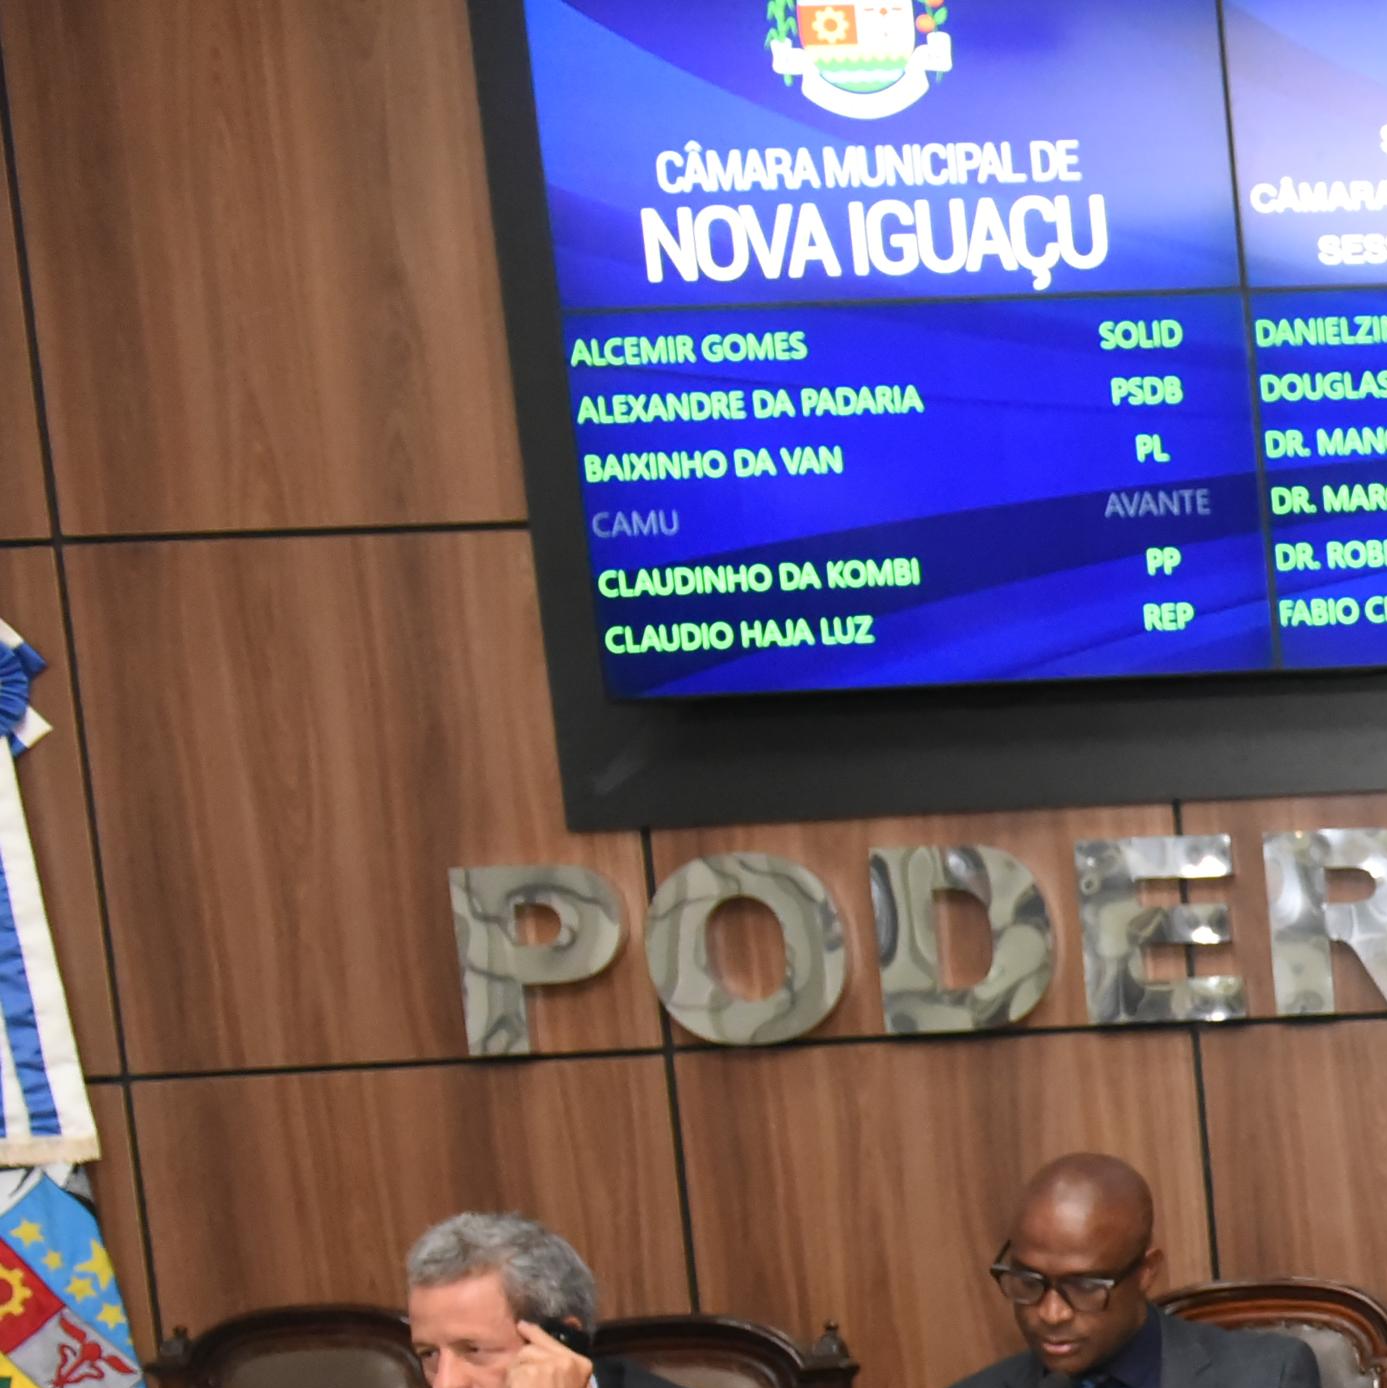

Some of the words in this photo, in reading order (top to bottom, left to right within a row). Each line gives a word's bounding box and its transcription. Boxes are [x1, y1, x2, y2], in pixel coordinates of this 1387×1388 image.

[656, 141, 821, 194] CÂMARA
[822, 140, 1028, 189] MUNICIPAL
[1030, 139, 1082, 183] DE
[641, 201, 842, 283] NOVA
[849, 194, 1108, 289] IGUAÇU
[570, 336, 697, 367] ALCEMIR
[701, 332, 808, 362] GOMES
[1099, 321, 1182, 349] SOLID
[577, 392, 745, 424] ALEXANDRE
[754, 391, 795, 419] DA
[802, 386, 924, 418] PADARIA
[1111, 377, 1182, 406] PSDB
[1136, 434, 1169, 463] PL
[1265, 429, 1310, 459] DR.
[584, 451, 728, 482] BAIXINHO
[735, 449, 776, 477] DA
[781, 446, 843, 475] VAN
[1104, 489, 1211, 519] AVANTE
[1271, 486, 1317, 516] DR.
[592, 509, 679, 538] CAMU
[1146, 548, 1181, 576] PP
[1275, 542, 1320, 571] DR.
[598, 566, 773, 600] CLAUDINHO
[779, 563, 821, 592] DA
[826, 557, 921, 589] KOMBI
[1143, 602, 1194, 631] REP
[1279, 598, 1359, 628] FABIO
[604, 622, 736, 654] CLAUDIO
[742, 619, 813, 651] HAJA
[821, 616, 875, 646] LUZ
